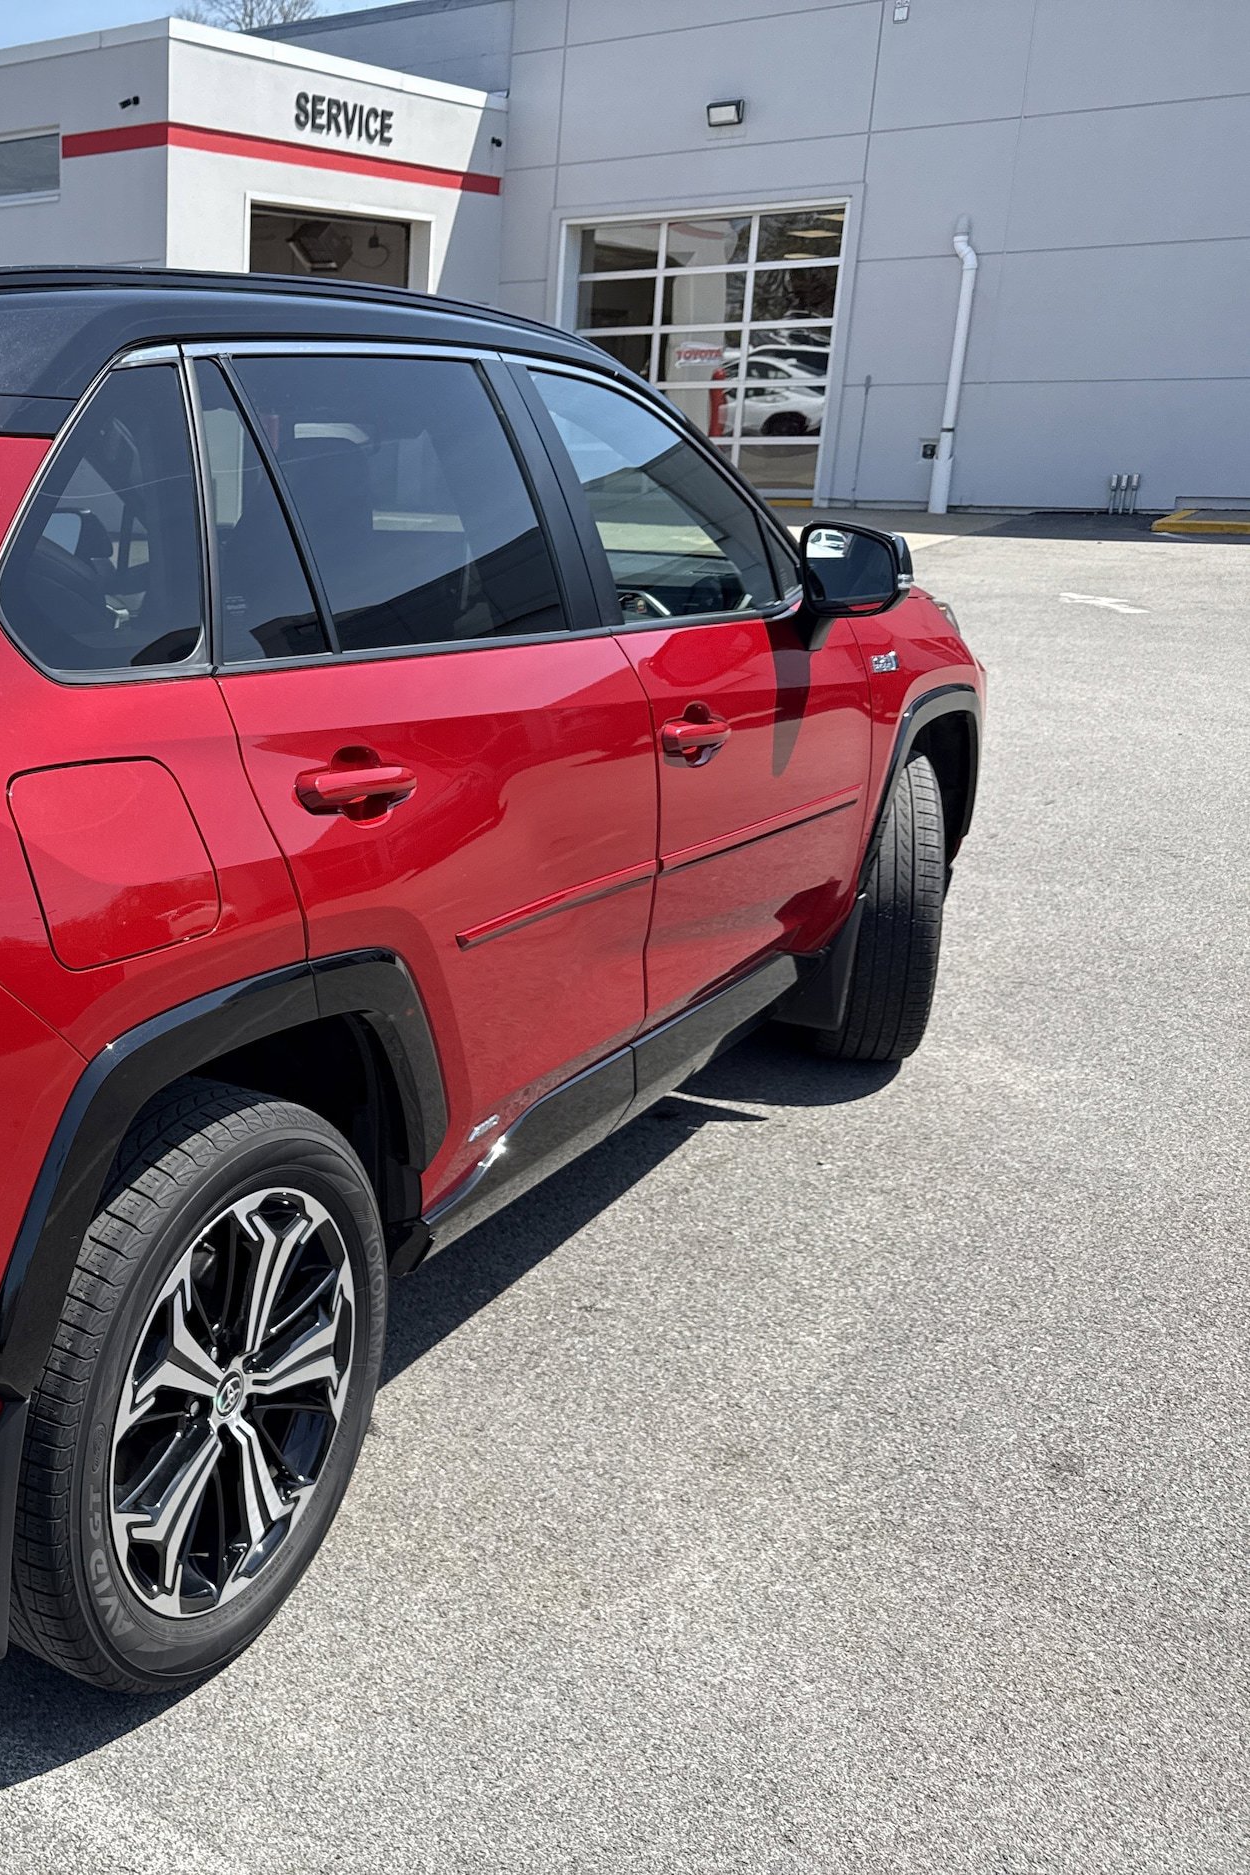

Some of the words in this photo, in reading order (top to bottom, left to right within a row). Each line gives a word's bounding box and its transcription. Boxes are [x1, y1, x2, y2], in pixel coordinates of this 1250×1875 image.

[294, 91, 393, 147] SERVICE
[363, 1222, 385, 1381] YOKOHAMA
[89, 1484, 102, 1540] GT
[90, 1549, 135, 1637] AVID
